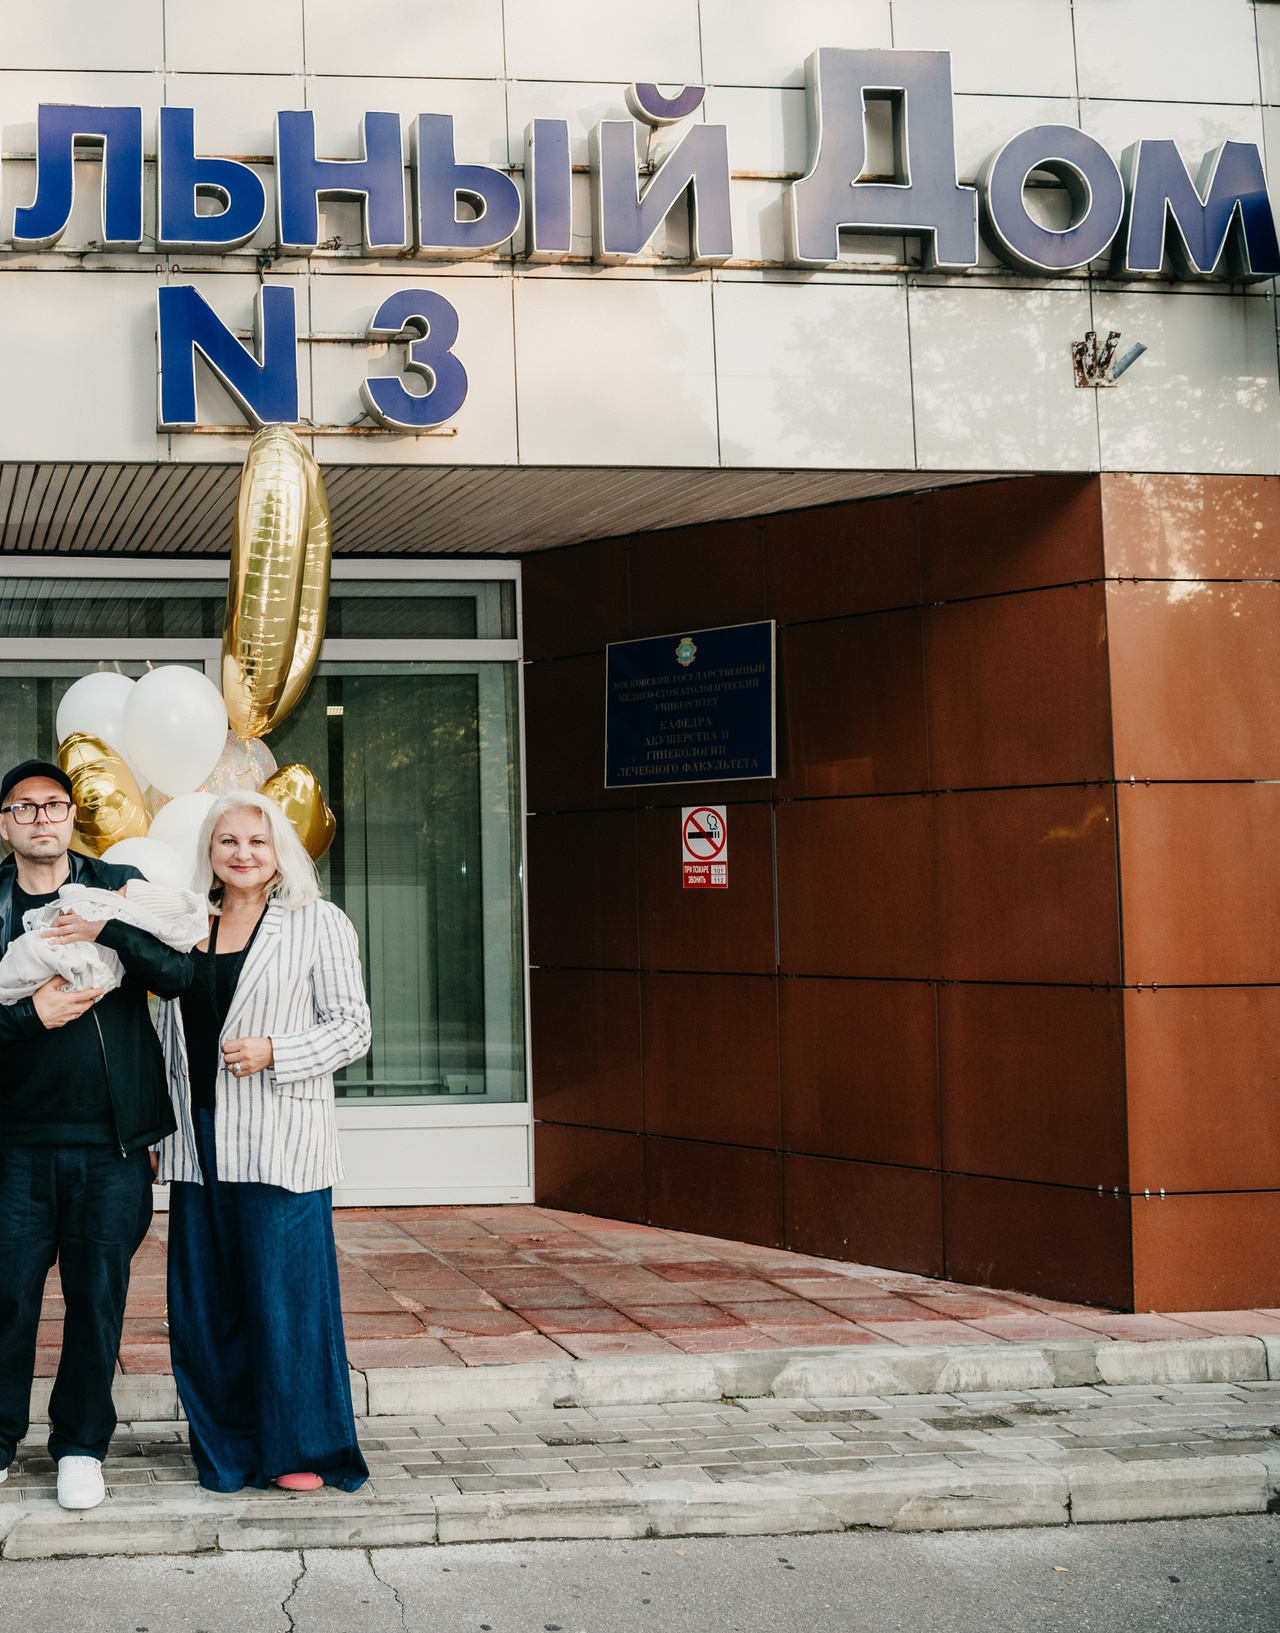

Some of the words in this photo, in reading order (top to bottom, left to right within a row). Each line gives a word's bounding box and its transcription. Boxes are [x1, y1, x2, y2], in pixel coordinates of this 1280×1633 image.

[784, 46, 1280, 283] Дом
[154, 284, 300, 433] N
[360, 287, 469, 433] 3
[613, 674, 670, 690] МОСКОВСКИЙ
[673, 663, 765, 683] ГОСУДАРСТВЕННЫЙ
[618, 678, 759, 703] МЕДИКО-СТОМАТОЛОГИЧЕСКИЙ
[654, 697, 719, 712] УНИВЕРСИТЕТ
[660, 716, 712, 730] КАФЕДРА
[644, 731, 718, 747] АКУШЕРСТВА
[721, 729, 730, 740] И
[646, 745, 727, 761] ГИНЕКОЛОГИИ
[617, 763, 679, 777] ЛЕЧЕБНОГО
[682, 758, 759, 773] ФАКУЛЬТЕТА
[684, 865, 692, 873] ПРИ
